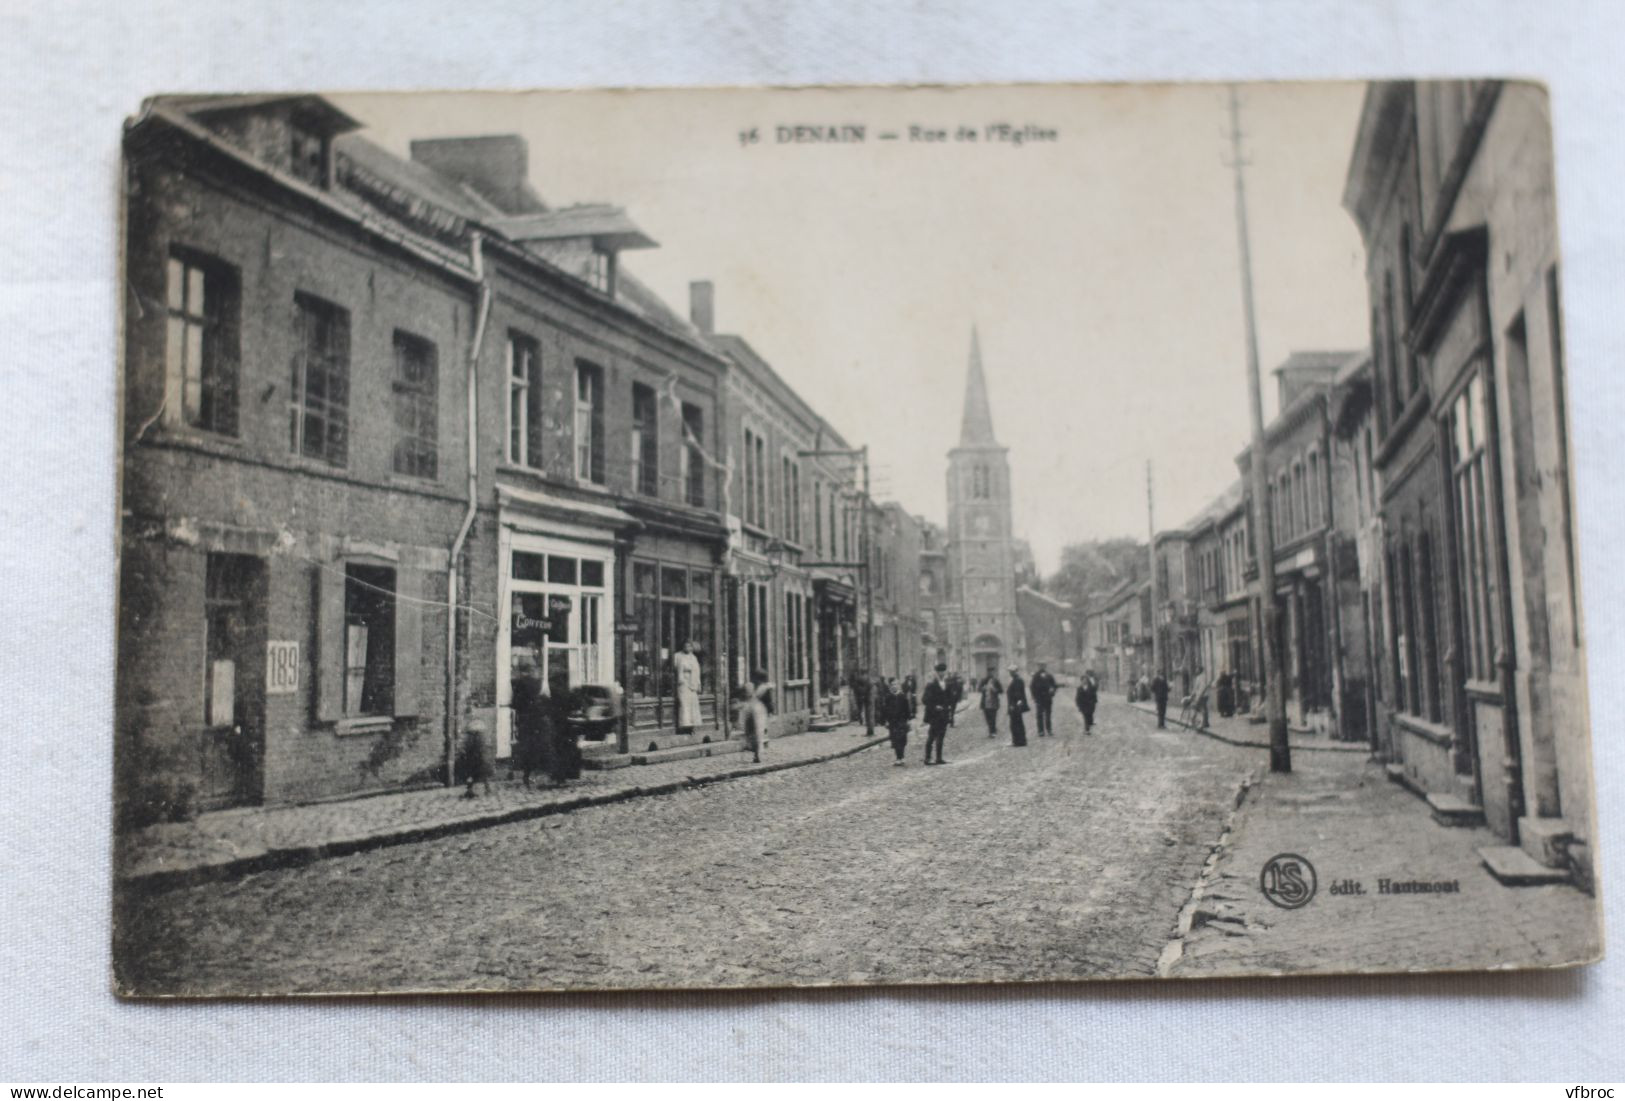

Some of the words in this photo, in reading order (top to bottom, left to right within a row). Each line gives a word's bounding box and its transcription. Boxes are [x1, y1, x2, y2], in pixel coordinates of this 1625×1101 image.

[775, 125, 866, 144] DENAIN
[908, 125, 946, 143] Rue
[954, 124, 977, 143] de
[270, 646, 298, 687] 189
[1329, 879, 1368, 897] édit.
